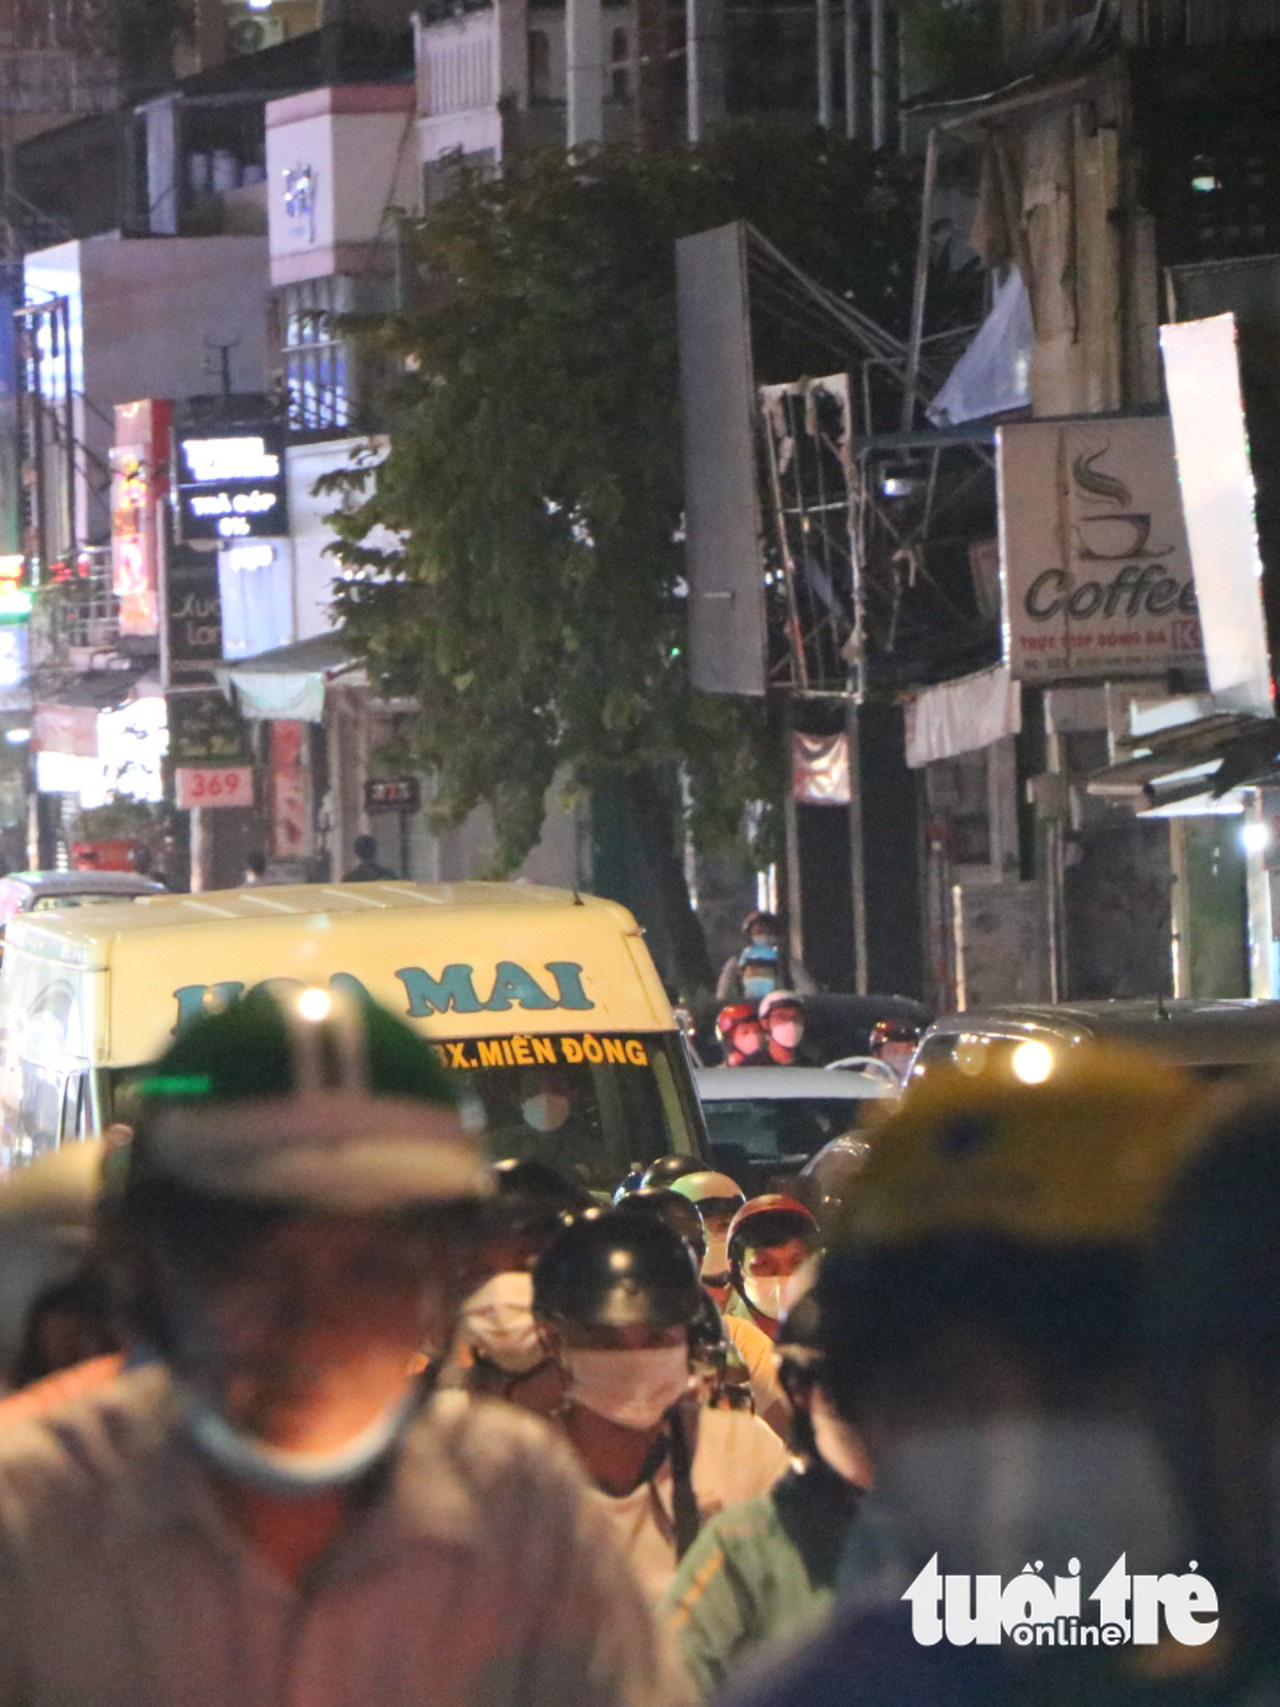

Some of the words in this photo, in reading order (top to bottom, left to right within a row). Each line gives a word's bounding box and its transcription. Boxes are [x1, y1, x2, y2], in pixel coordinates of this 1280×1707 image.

[1024, 563, 1200, 622] Coffee
[190, 773, 241, 798] 369
[395, 961, 596, 1017] MAI
[560, 1033, 648, 1066] ĐÔNG
